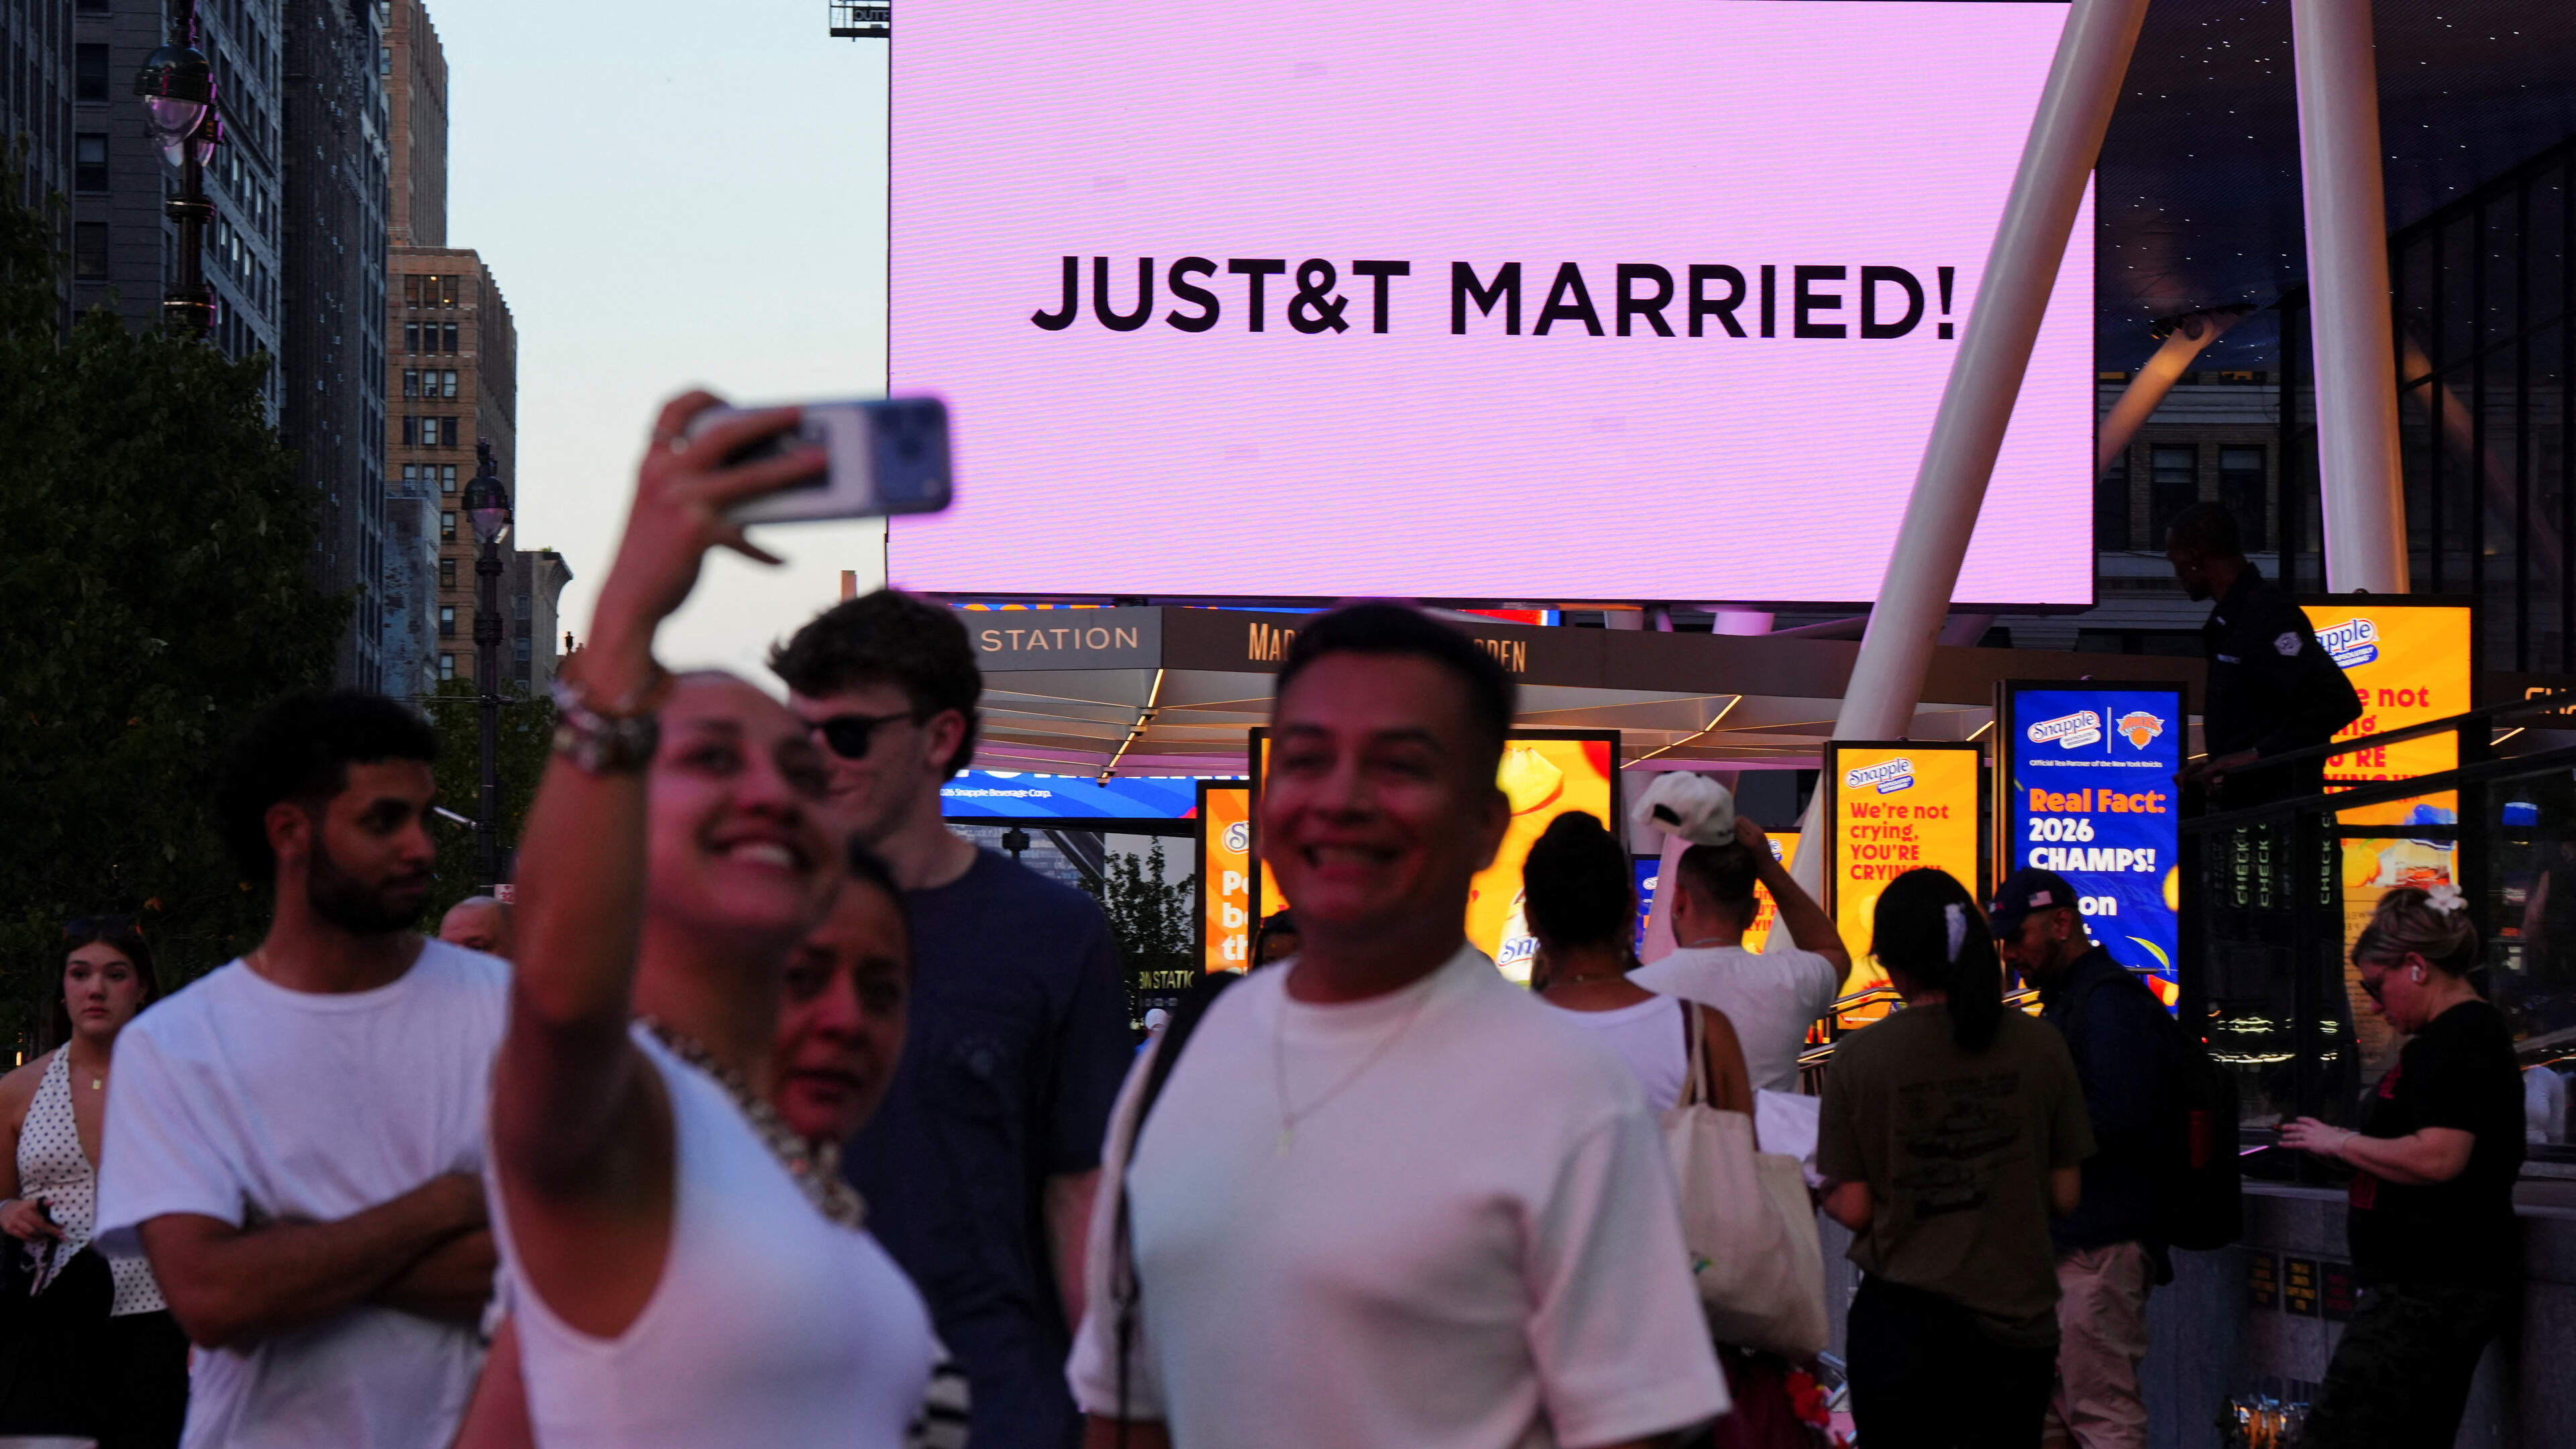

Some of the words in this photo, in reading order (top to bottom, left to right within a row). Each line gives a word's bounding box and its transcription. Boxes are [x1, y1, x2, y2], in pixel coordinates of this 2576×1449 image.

[1030, 256, 1410, 335] JUST&T
[1451, 261, 1955, 339] MARRIED!
[981, 627, 1138, 652] STATION
[2377, 685, 2429, 708] not
[2033, 712, 2094, 740] Snapple
[1848, 757, 1909, 786] Snapple
[955, 788, 988, 798] Snapple
[2029, 788, 2092, 812] Real
[2098, 789, 2166, 813] Fact:
[1850, 802, 1909, 818] We're
[1914, 804, 1949, 819] not
[1850, 820, 1919, 842] crying,
[2029, 817, 2094, 842] 2026
[1850, 844, 1919, 861] YOU'RE
[2029, 847, 2156, 873] CHAMPS!
